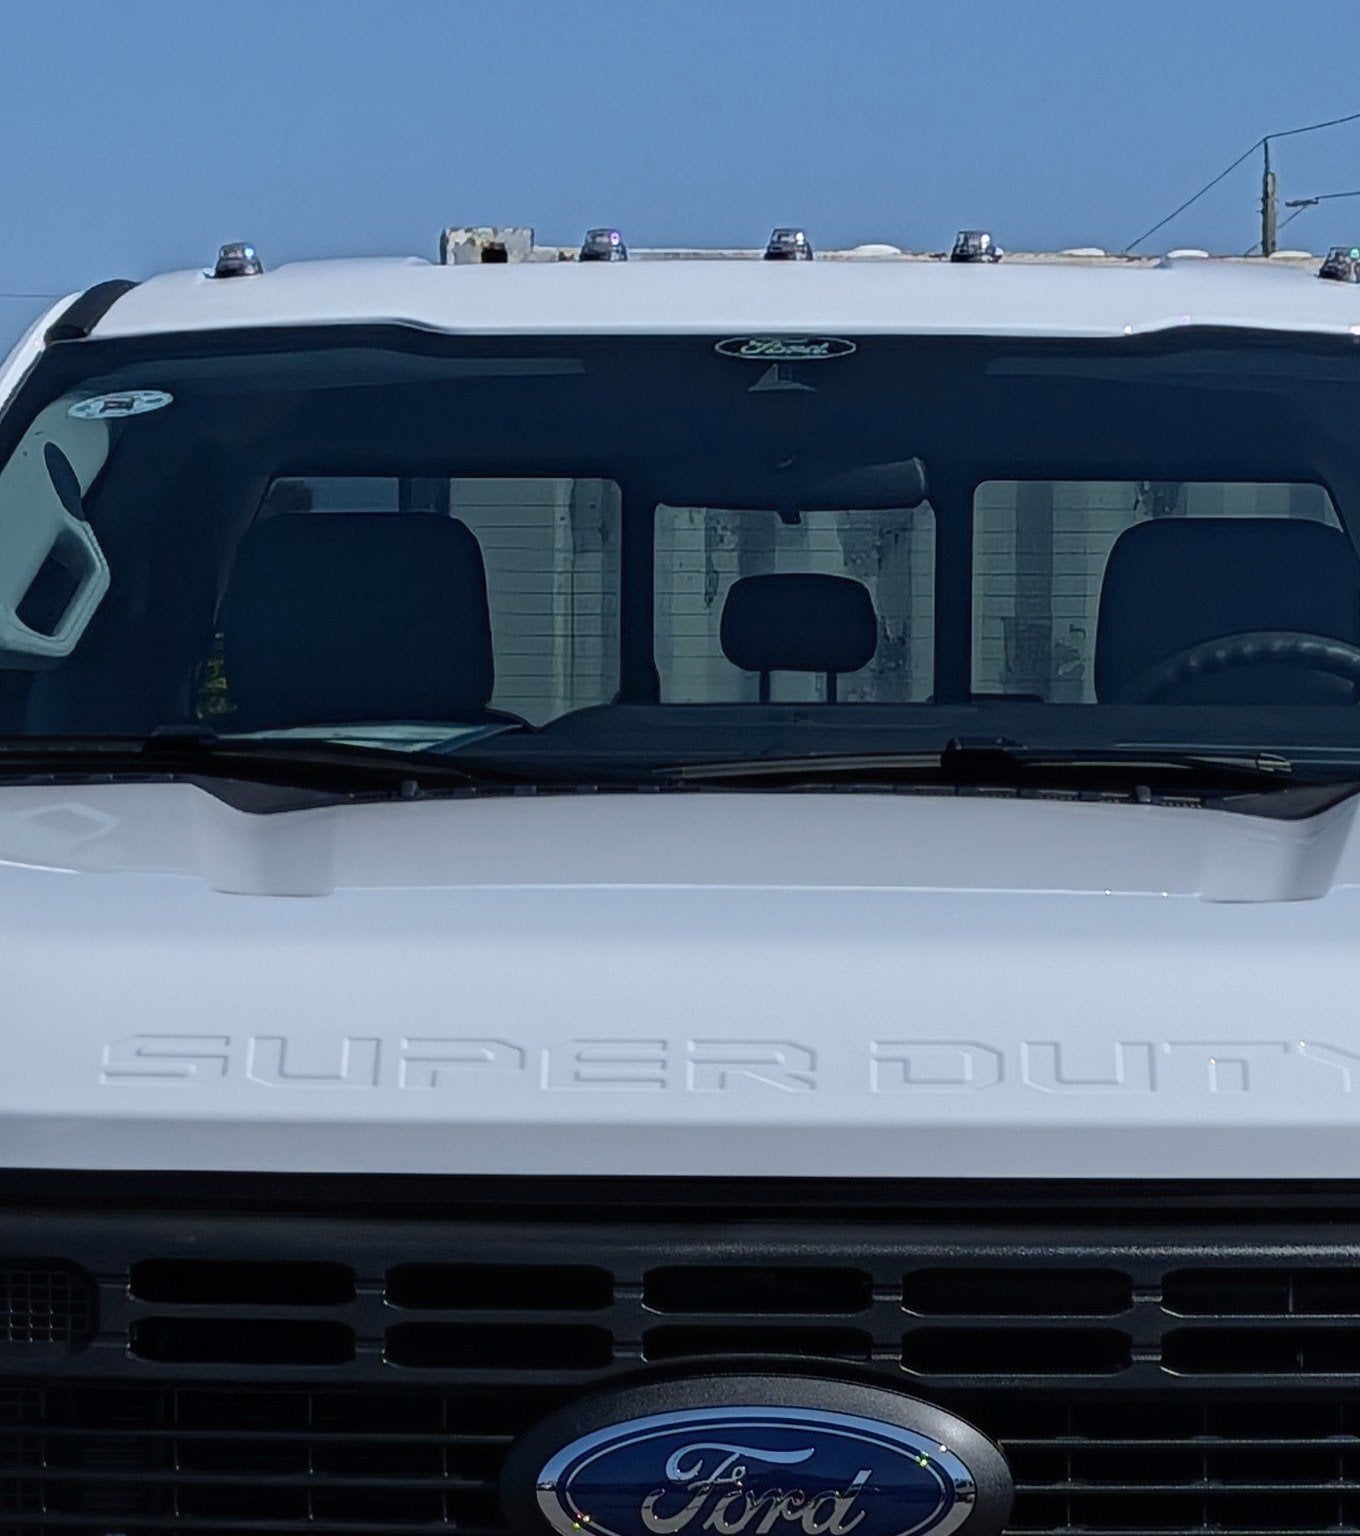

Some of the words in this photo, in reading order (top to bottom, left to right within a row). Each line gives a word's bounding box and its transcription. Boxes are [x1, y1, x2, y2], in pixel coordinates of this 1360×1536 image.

[740, 338, 830, 354] Ford
[97, 1032, 818, 1093] SUPER
[641, 1442, 873, 1536] Ford
